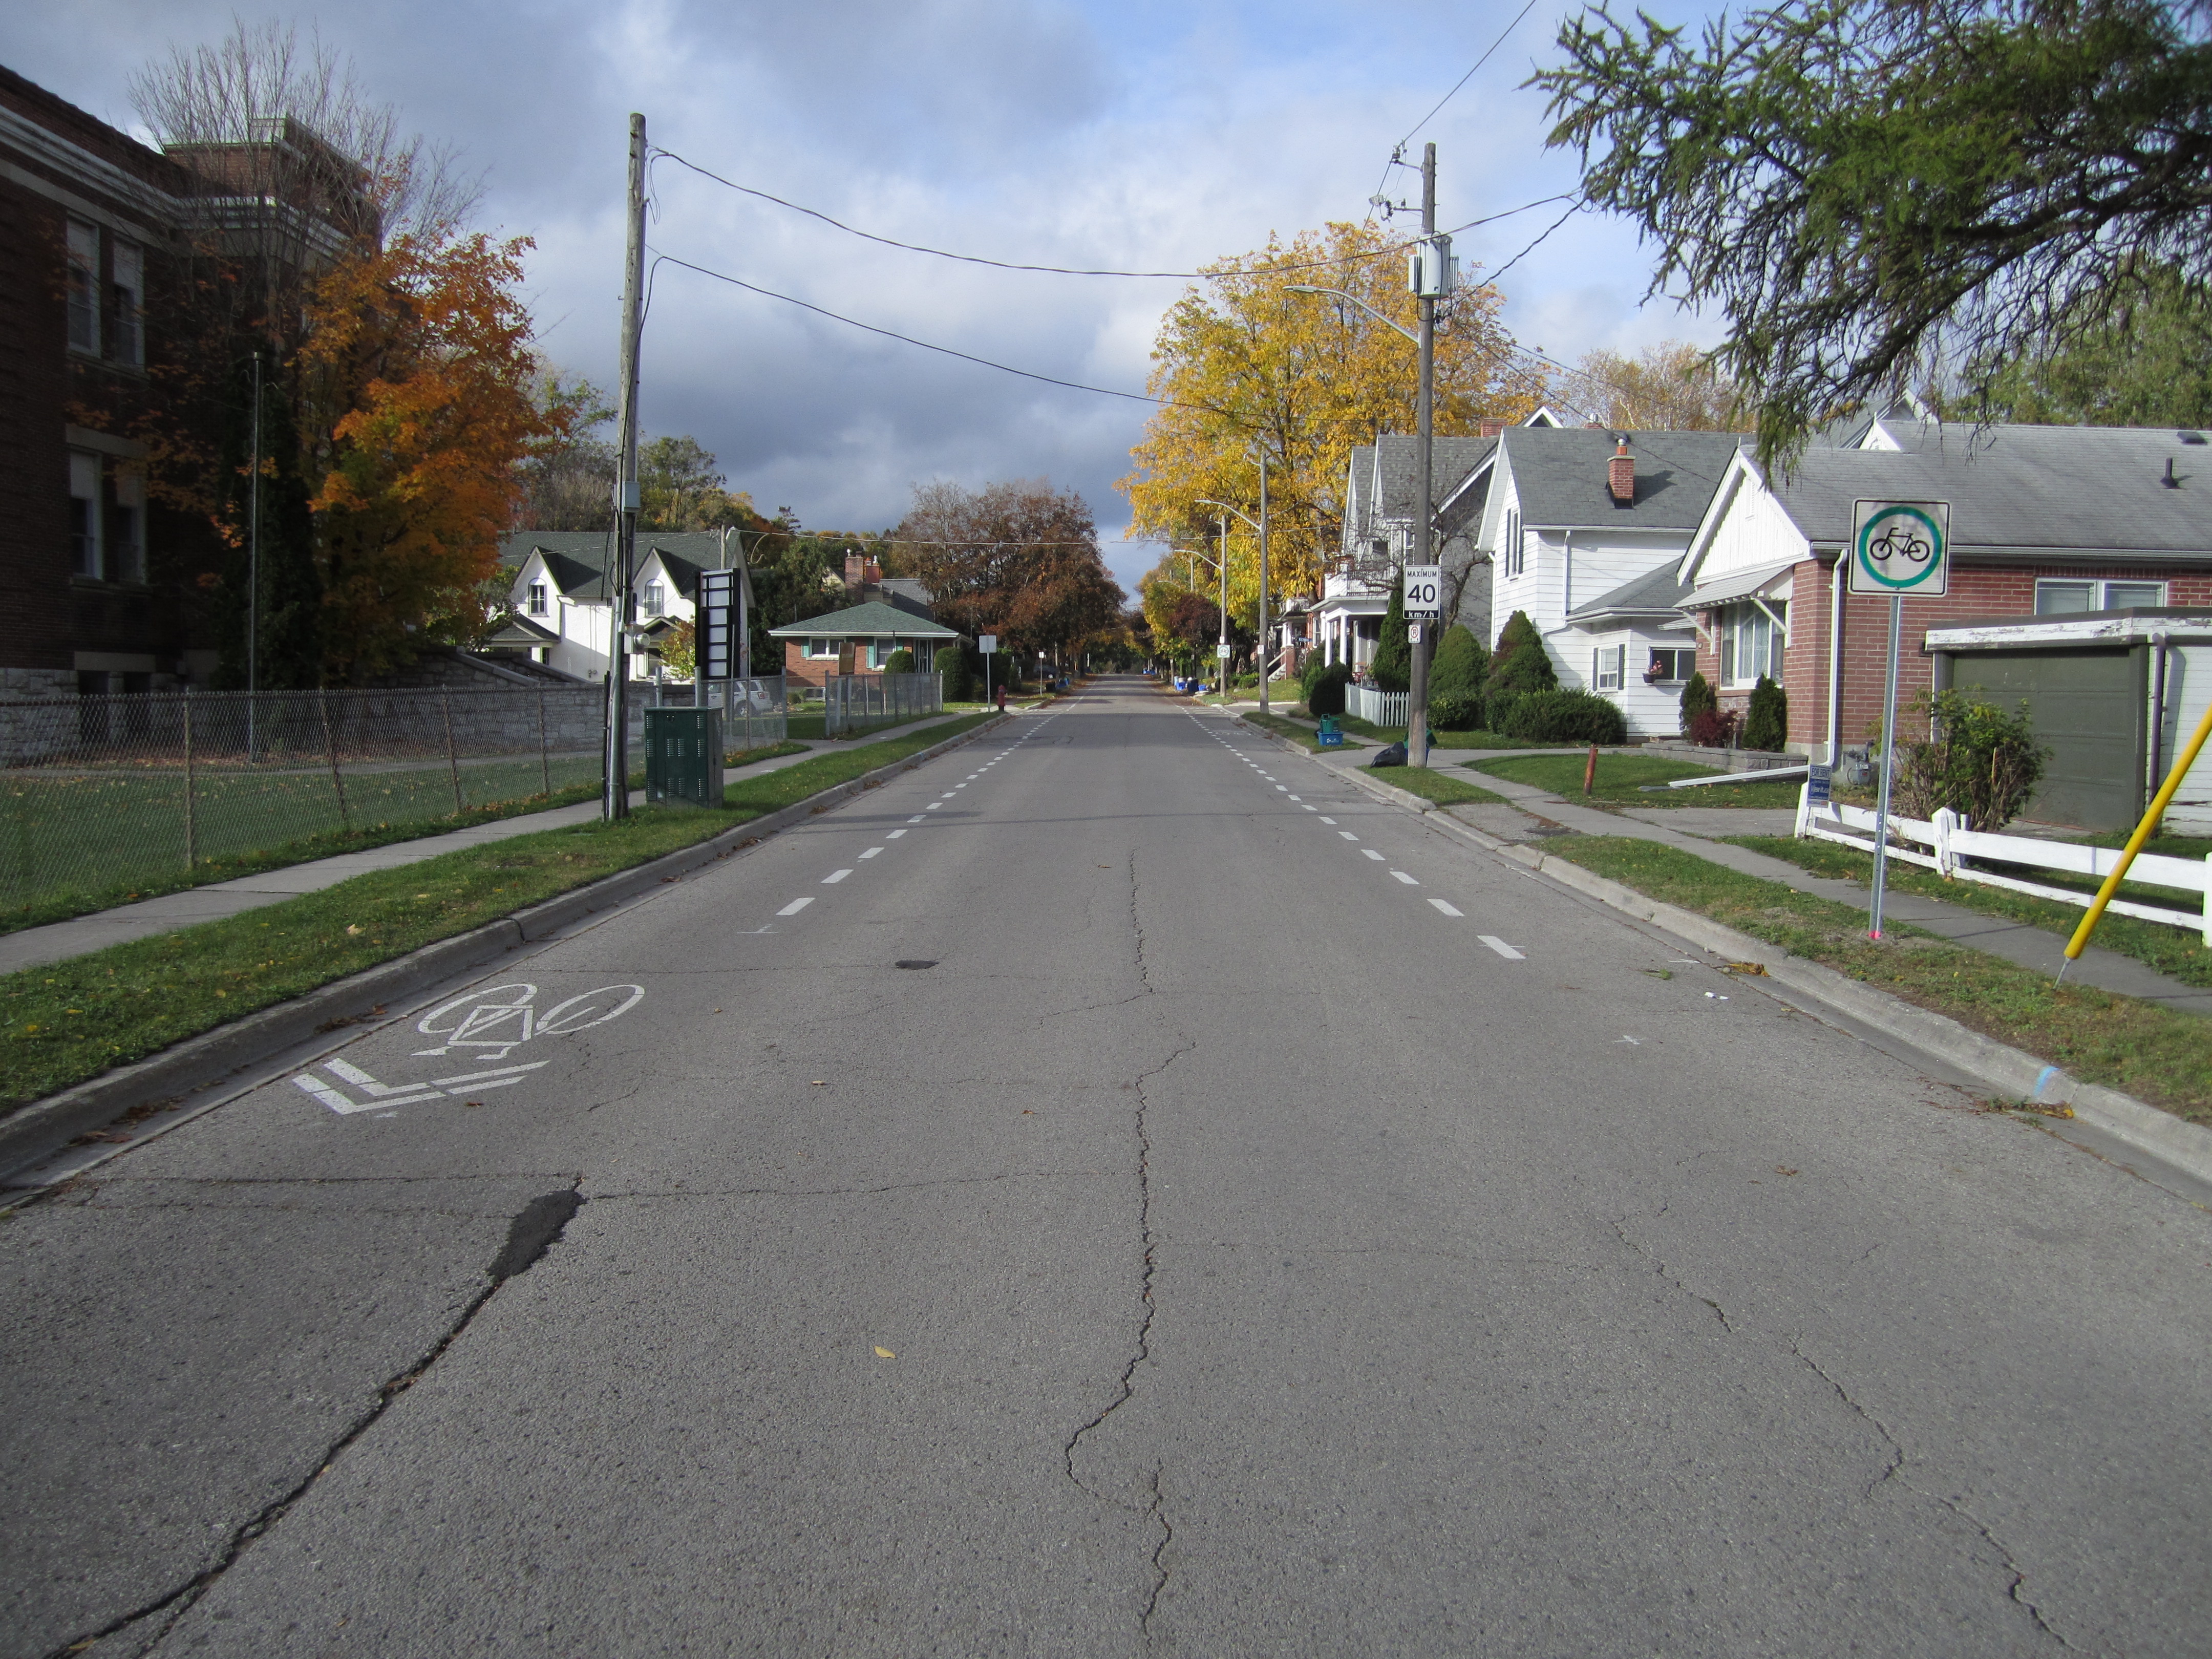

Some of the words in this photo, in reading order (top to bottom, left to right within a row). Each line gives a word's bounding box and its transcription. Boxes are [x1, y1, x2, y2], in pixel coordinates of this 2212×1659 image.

[1408, 584, 1436, 603] 40
[1812, 768, 1820, 776] FOR
[1820, 769, 1830, 778] RENT
